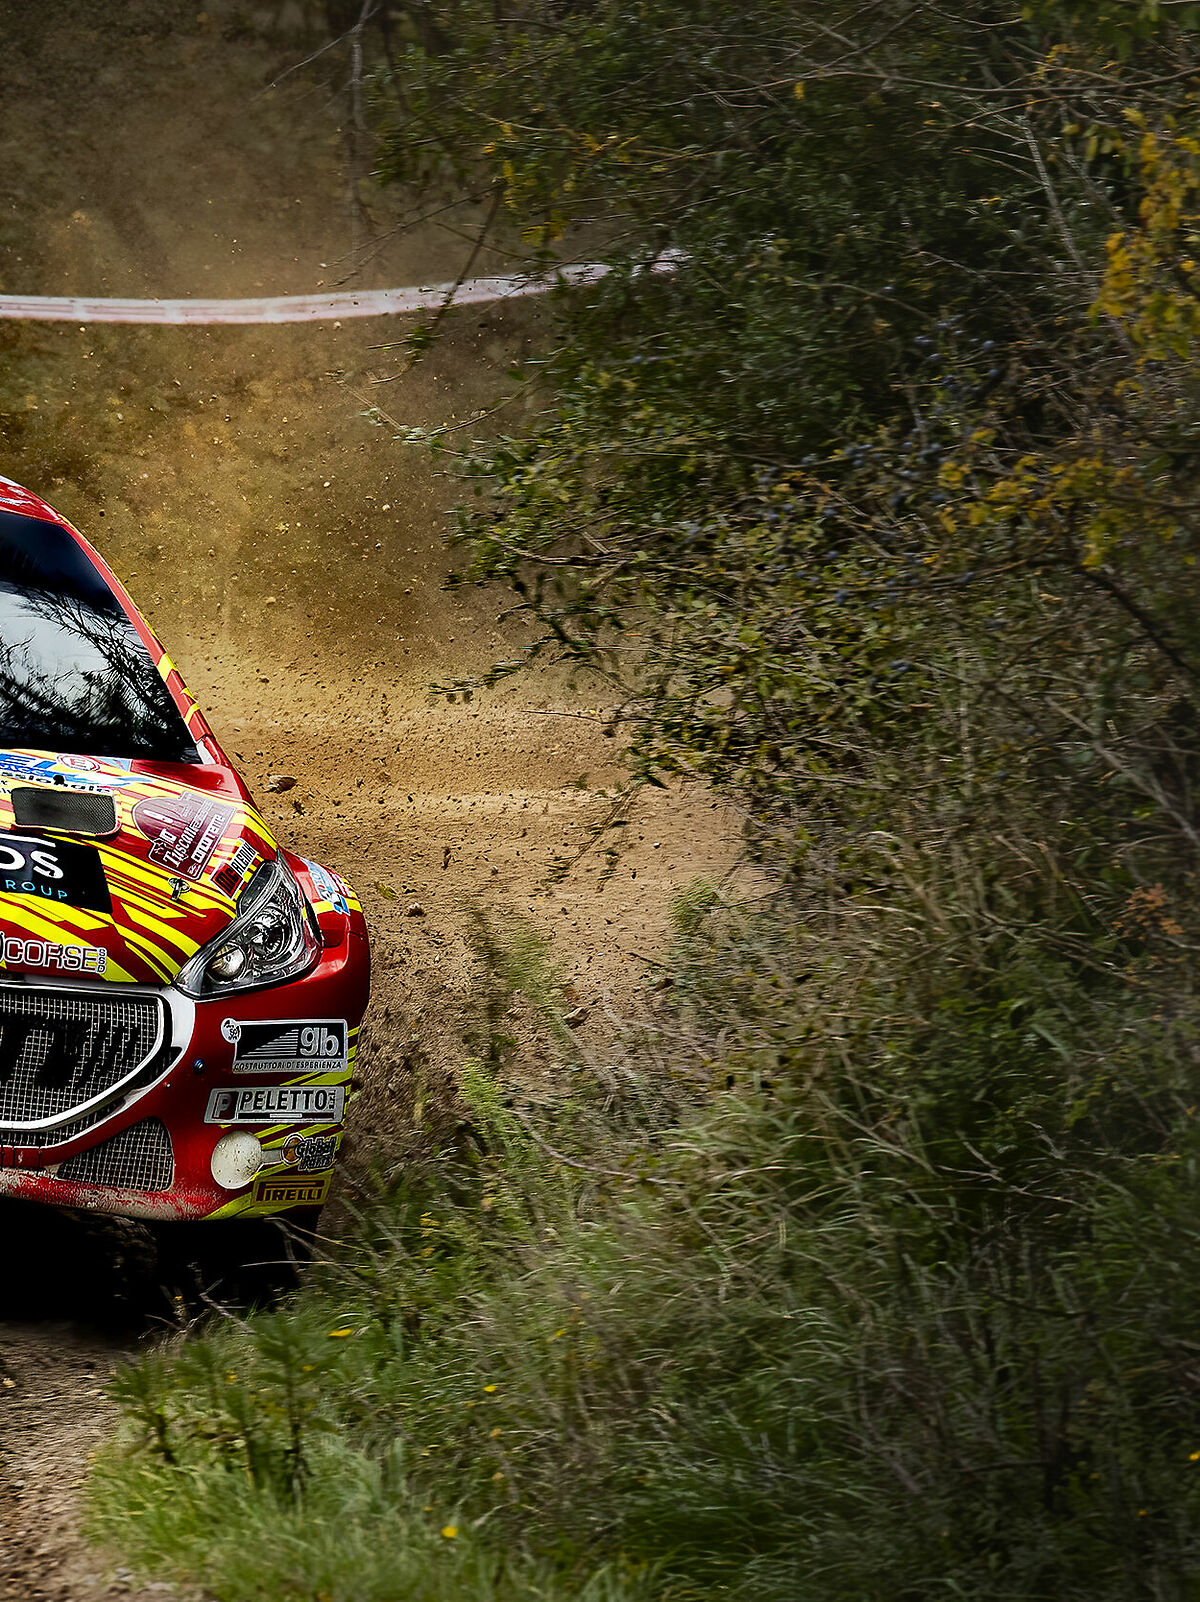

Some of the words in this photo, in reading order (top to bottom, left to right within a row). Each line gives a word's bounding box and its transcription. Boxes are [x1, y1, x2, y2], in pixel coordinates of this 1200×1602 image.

[4, 937, 99, 974] CORSE
[240, 1089, 328, 1110] PELETTO
[256, 1180, 324, 1200] PIRELLI
